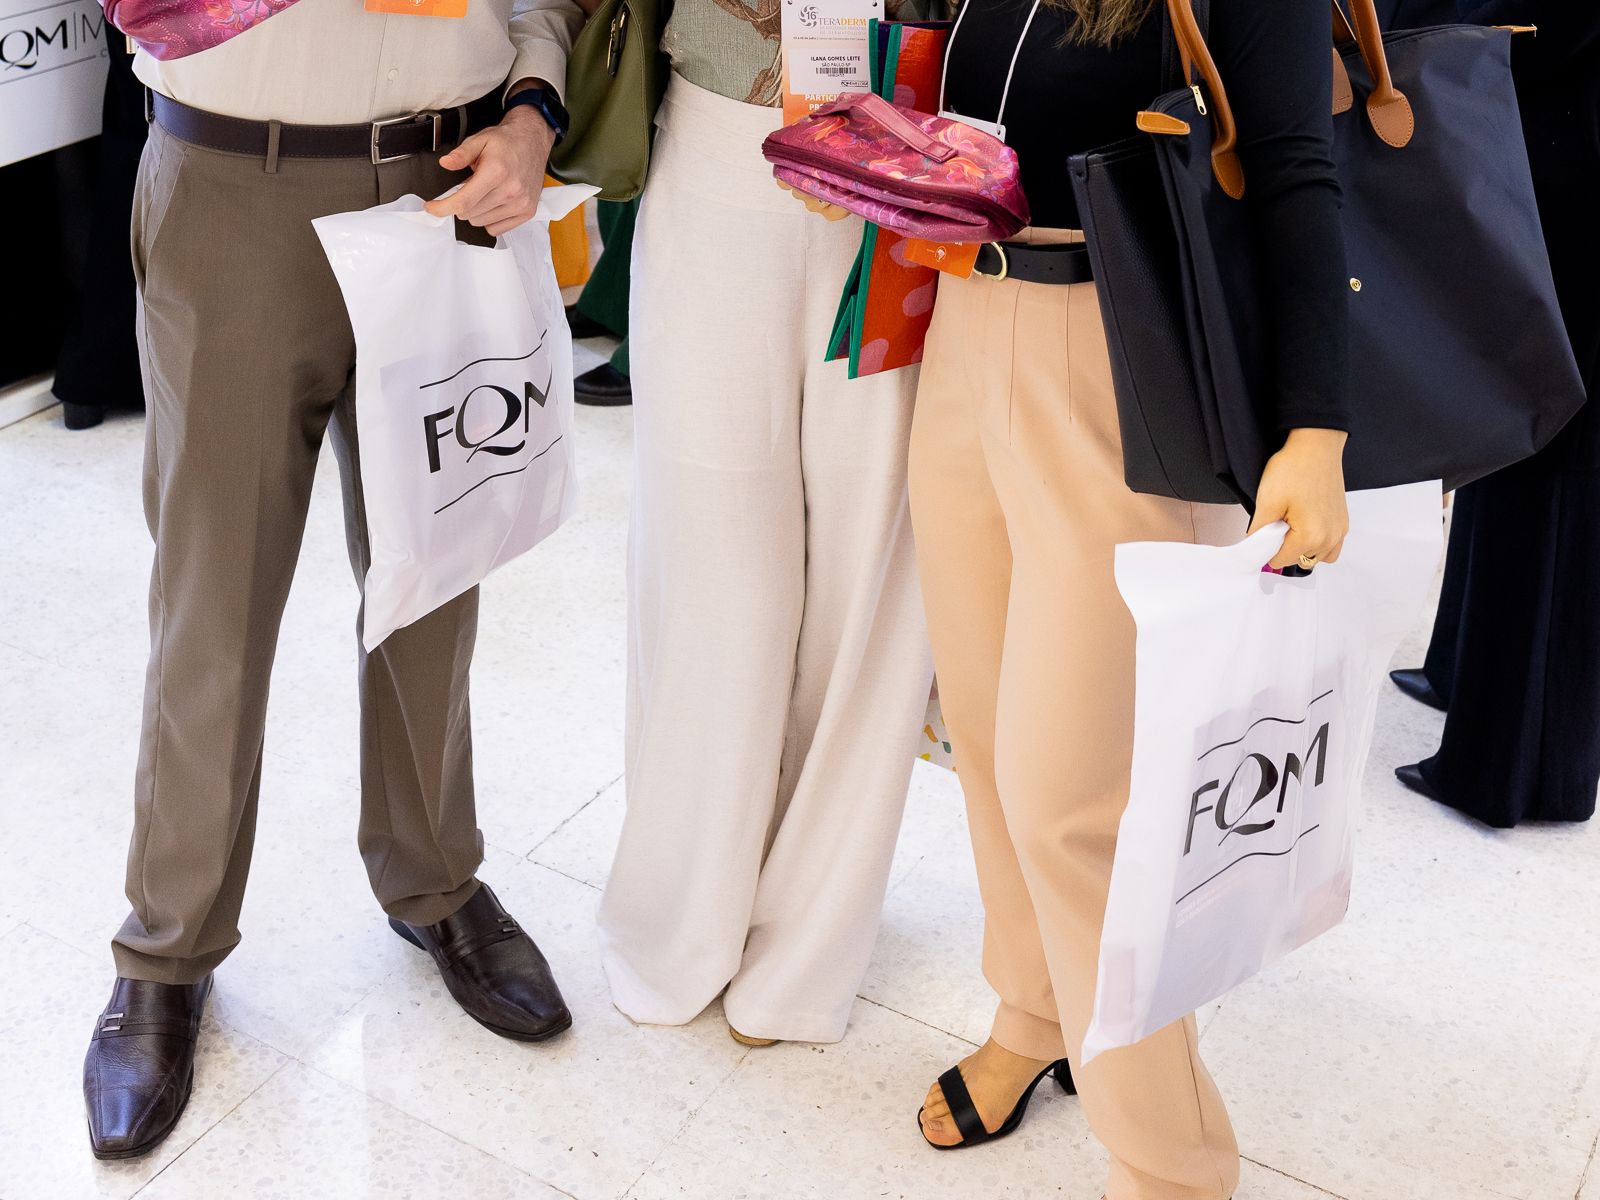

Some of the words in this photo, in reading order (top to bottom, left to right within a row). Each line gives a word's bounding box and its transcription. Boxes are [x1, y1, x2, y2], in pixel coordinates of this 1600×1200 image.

[819, 17, 867, 26] TERADERM
[0, 18, 68, 70] QM
[804, 94, 838, 102] PARTICI
[1183, 721, 1330, 858] FQM
